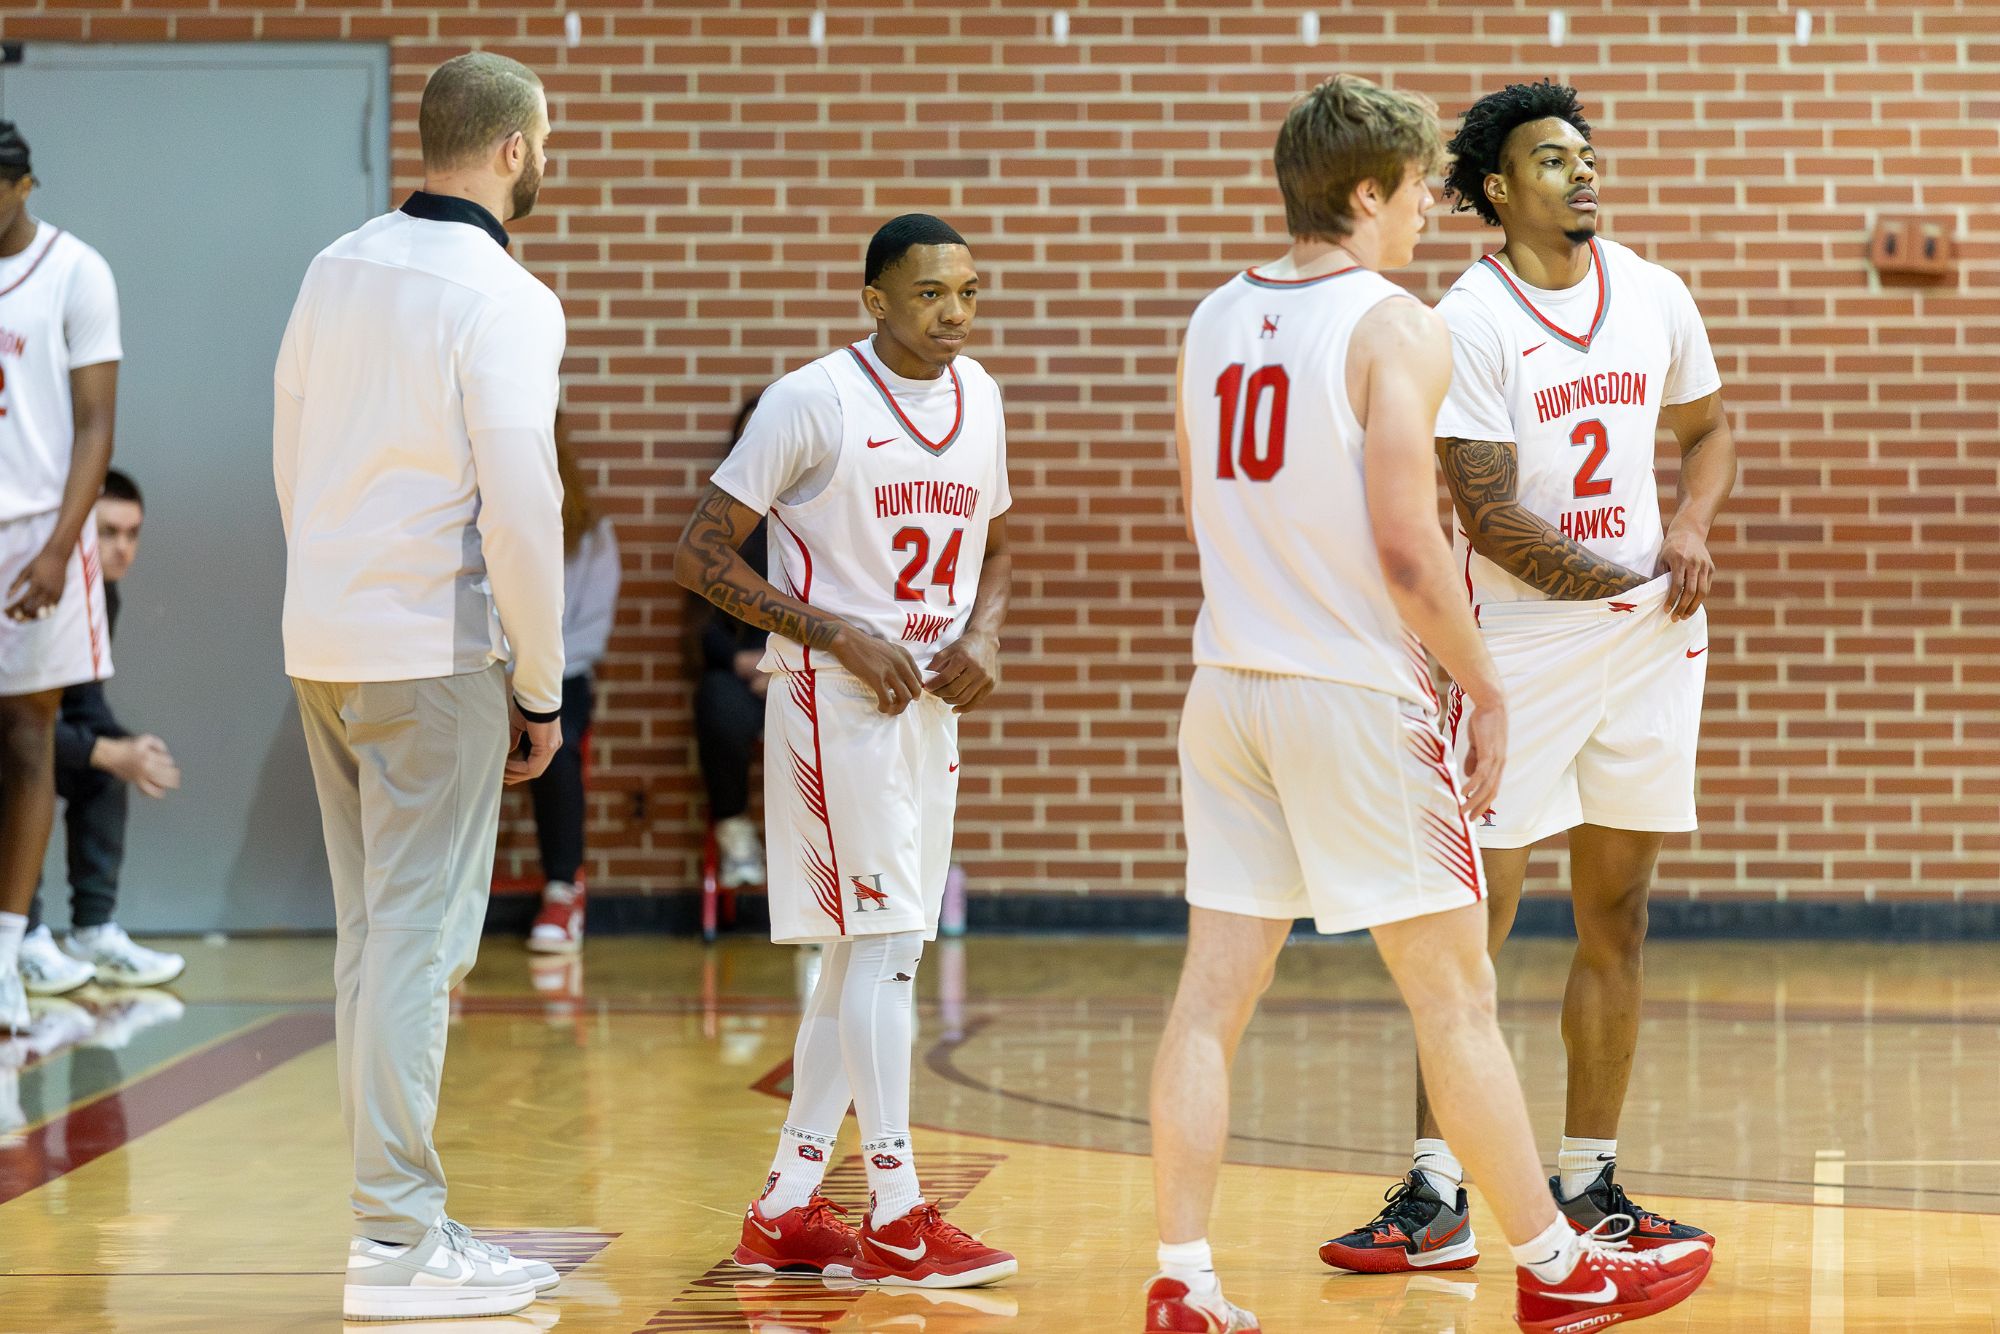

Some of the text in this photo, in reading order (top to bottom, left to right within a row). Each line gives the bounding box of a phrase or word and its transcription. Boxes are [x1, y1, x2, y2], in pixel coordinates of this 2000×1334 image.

[1214, 362, 1290, 482] 10
[1534, 371, 1647, 423] HUNTINGDON
[1569, 418, 1613, 499] 2
[1560, 506, 1626, 542] HAWKS
[892, 526, 964, 606] 24
